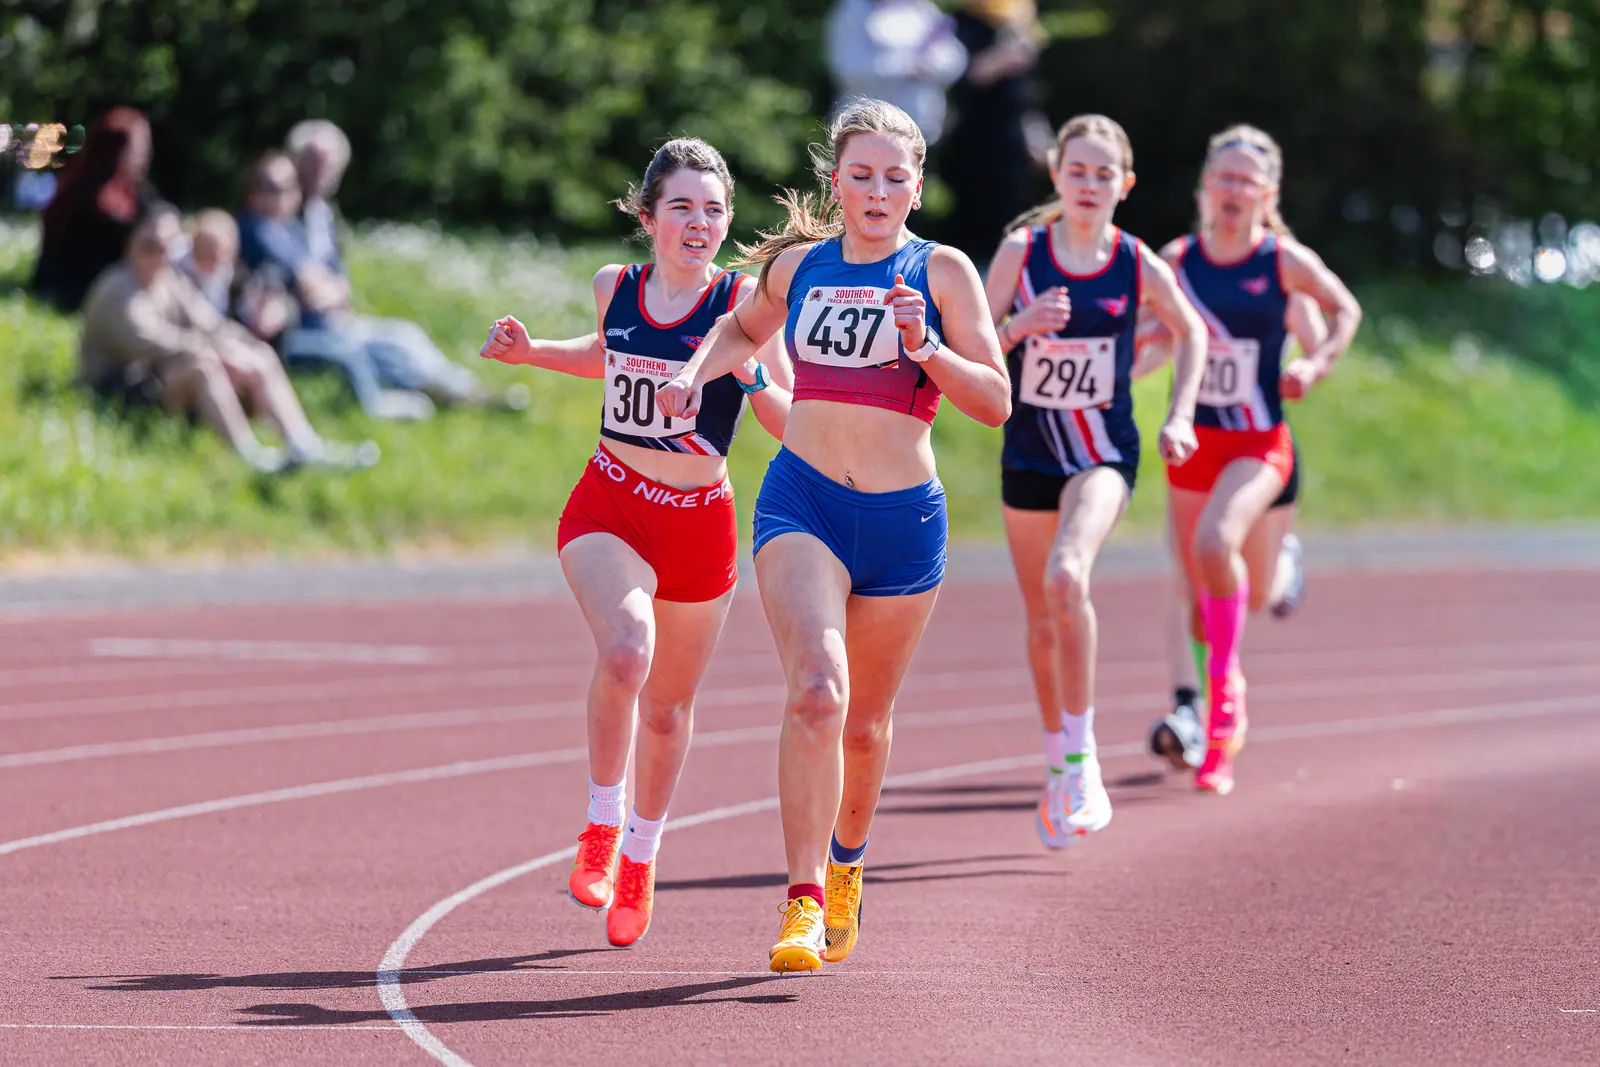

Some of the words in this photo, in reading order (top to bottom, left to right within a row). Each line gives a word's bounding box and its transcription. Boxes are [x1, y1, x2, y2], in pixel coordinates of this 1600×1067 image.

[834, 289, 874, 299] SOUTHEND
[807, 305, 886, 358] 437
[620, 365, 634, 373] TRACK
[646, 369, 659, 377] FIELD
[626, 356, 667, 371] SOUTHEND
[1036, 358, 1098, 400] 294
[633, 481, 700, 508] NIKE
